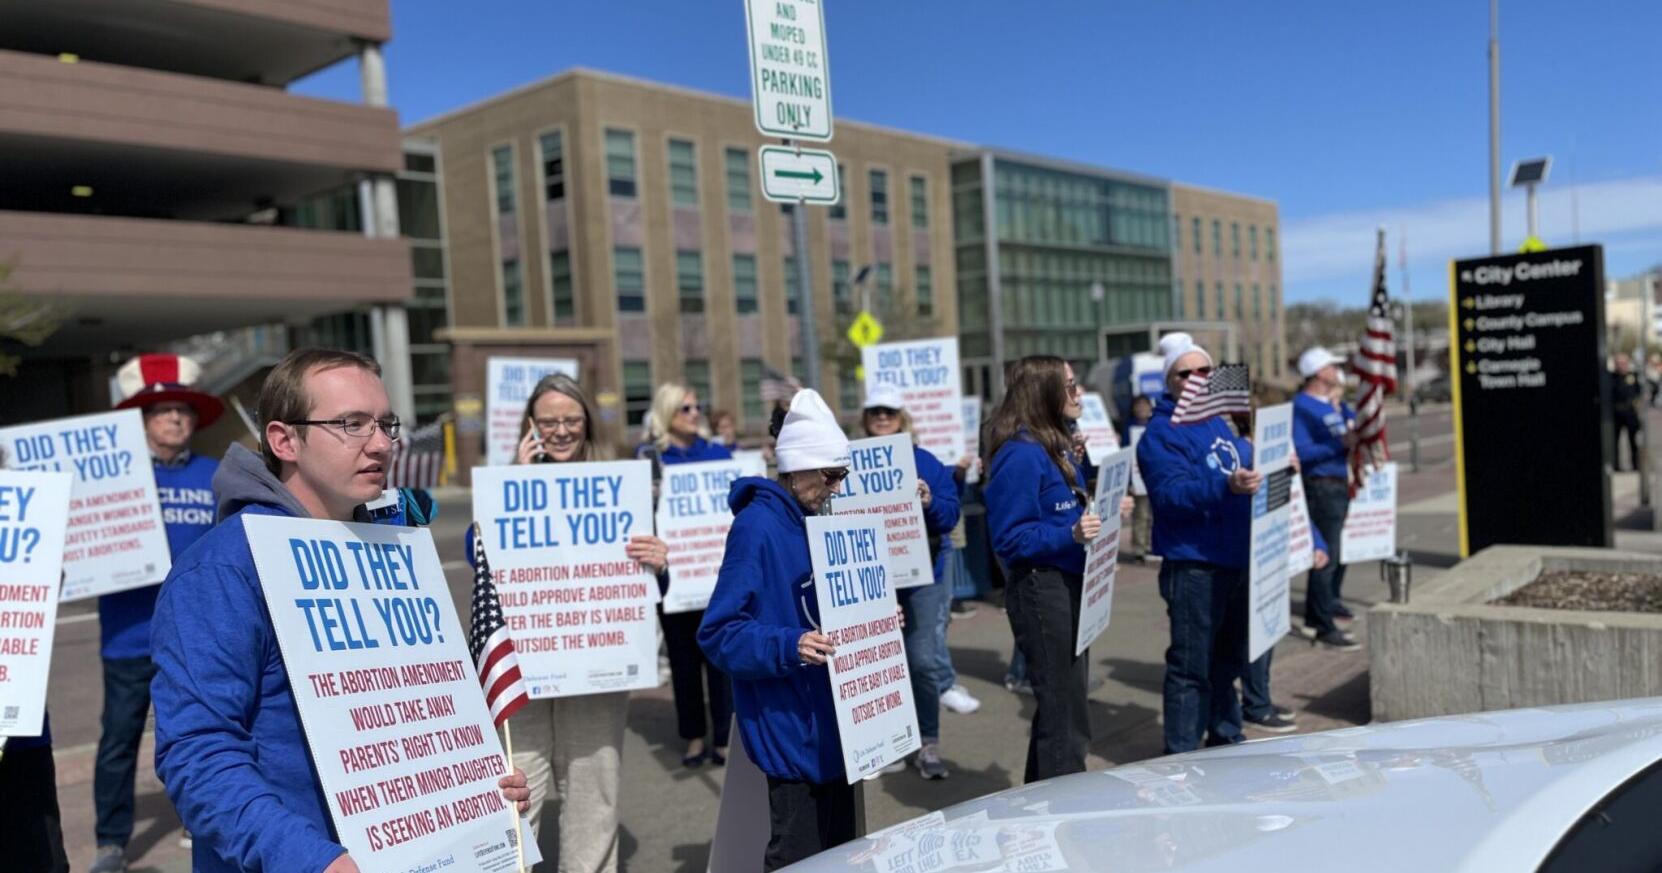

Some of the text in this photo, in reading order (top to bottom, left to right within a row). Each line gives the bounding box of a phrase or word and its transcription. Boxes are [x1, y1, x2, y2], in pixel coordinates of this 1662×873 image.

[776, 2, 796, 20] AND
[770, 22, 805, 44] MOPED
[762, 44, 790, 64] UNDER
[806, 50, 818, 68] CC
[762, 68, 822, 100] PARKING
[776, 102, 811, 128] ONLY
[1474, 259, 1582, 286] City Center
[1475, 293, 1524, 310] Library
[1476, 311, 1583, 331] County Campus
[878, 346, 942, 368] DID THEY
[1477, 334, 1536, 354] City Hall
[912, 366, 948, 386] YOU?
[1478, 356, 1542, 374] Carnegie
[1478, 372, 1546, 388] Town Hall
[14, 424, 118, 463] DID THEY
[73, 450, 132, 482] YOU?
[504, 476, 623, 512] DID THEY
[670, 472, 698, 494] DID
[859, 468, 904, 494] YOU?
[666, 496, 706, 518] TELL
[494, 511, 634, 550] TELL YOU?
[910, 516, 918, 525] BY
[824, 528, 878, 566] DID THEY
[288, 538, 420, 590] DID THEY
[491, 569, 506, 584] HE
[510, 565, 570, 584] ABORTION
[498, 583, 647, 608] OULD APPROVE ABORTION
[826, 564, 887, 608] TELL YOU?
[296, 596, 445, 652] TELL YOU?
[530, 613, 553, 629] THE
[556, 610, 587, 628] BABY
[590, 610, 602, 626] IS
[605, 606, 646, 624] VIABLE
[841, 623, 868, 645] ABORTION
[868, 616, 898, 638] AMENDMENT
[561, 634, 584, 650] THE
[587, 631, 628, 648] WOMB.
[833, 640, 902, 675] WOULD APPROVE ABORTION
[308, 660, 467, 698] THE ABORTION AMENDMENT
[839, 664, 906, 701] AFTER THE BABY IS VIABLE
[349, 694, 457, 732] WOULD TAKE AWAY
[852, 700, 876, 725] OUTSIDE
[874, 696, 886, 714] THE
[402, 732, 437, 760] RIGHT
[436, 730, 453, 752] TO
[452, 724, 485, 748] KNOW
[336, 754, 506, 818] WHEN THEIR MINOR DAUGHTER
[366, 790, 508, 852] IS SEEKING AN ABORTION.
[437, 854, 455, 869] Fund
